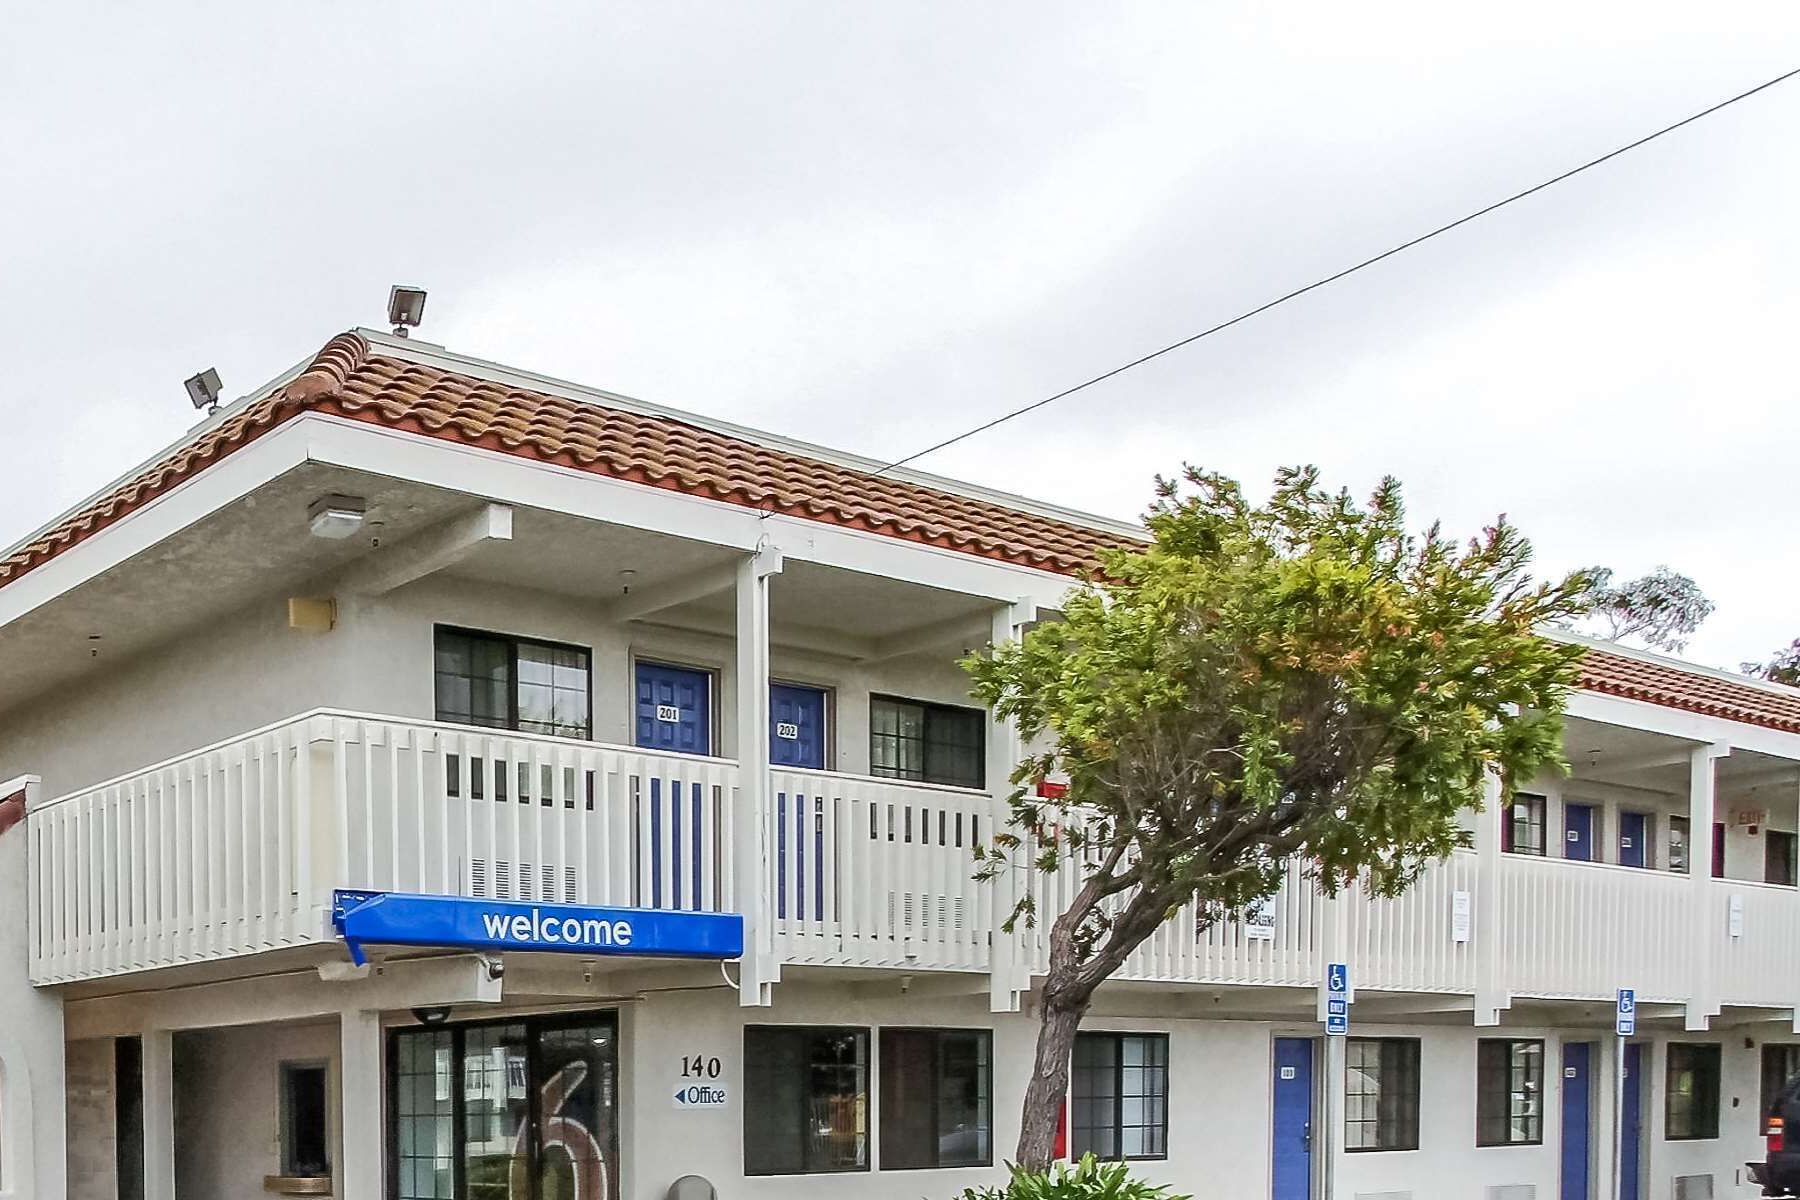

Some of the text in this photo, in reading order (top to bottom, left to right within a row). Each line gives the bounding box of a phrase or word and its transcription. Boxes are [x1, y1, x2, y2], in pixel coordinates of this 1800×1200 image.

[660, 707, 677, 720] 201
[779, 725, 796, 737] 202
[482, 908, 632, 946] welcome
[680, 1054, 721, 1079] 140
[687, 1086, 725, 1104] Office
